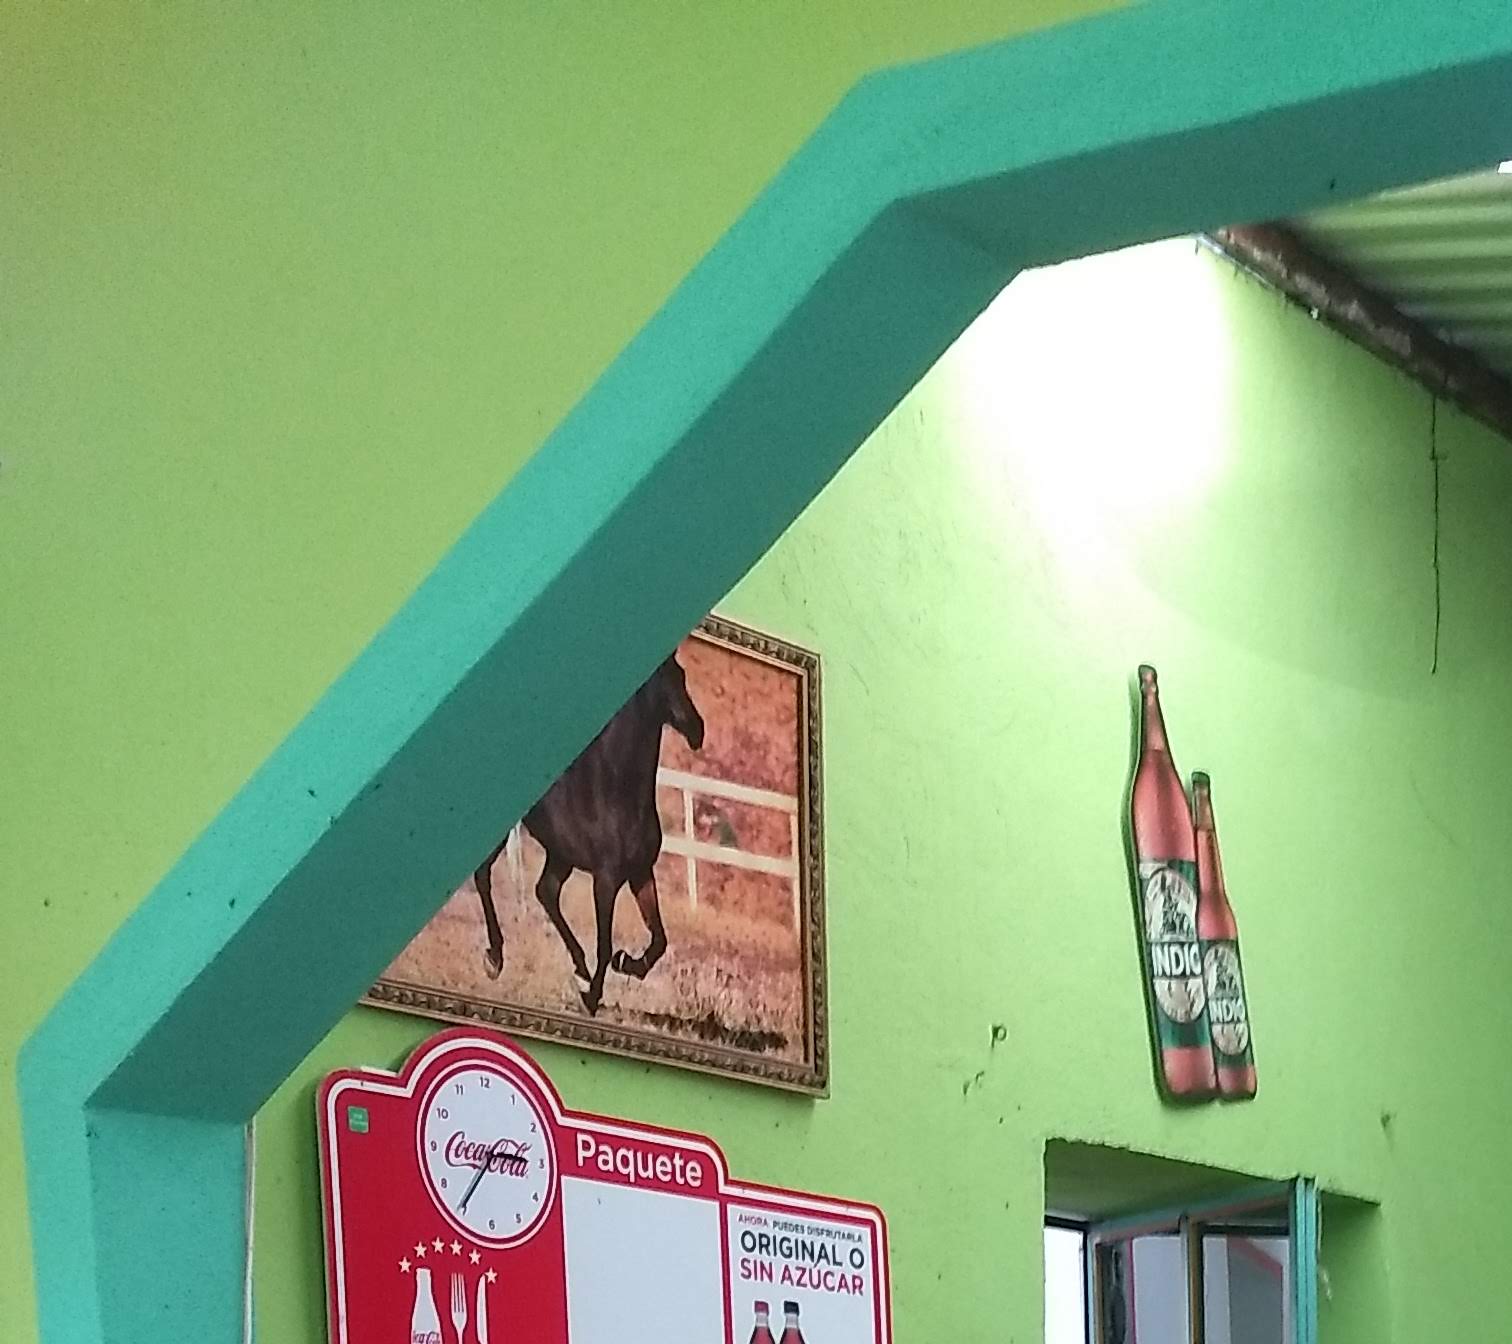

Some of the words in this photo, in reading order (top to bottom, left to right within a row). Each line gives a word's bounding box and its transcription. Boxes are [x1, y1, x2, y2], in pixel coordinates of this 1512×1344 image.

[1151, 943, 1202, 977] INDIO
[479, 1076, 490, 1089] 12
[455, 1084, 464, 1095] 11
[510, 1094, 516, 1105] 1
[436, 1107, 449, 1119] 10
[530, 1123, 537, 1133] 2
[430, 1140, 437, 1151] 9
[539, 1159, 545, 1169] 3
[576, 1132, 703, 1187] Paquete
[440, 1177, 448, 1189] 8
[532, 1191, 539, 1202] 4
[515, 1213, 522, 1224] 5
[738, 1213, 769, 1227] AHORA
[772, 1220, 805, 1235] PUEDES
[488, 1219, 496, 1230] 6
[740, 1230, 843, 1268] ORIGINAL
[849, 1247, 865, 1270] O
[740, 1257, 773, 1284] SIN
[780, 1260, 864, 1296] AZÚCAR
